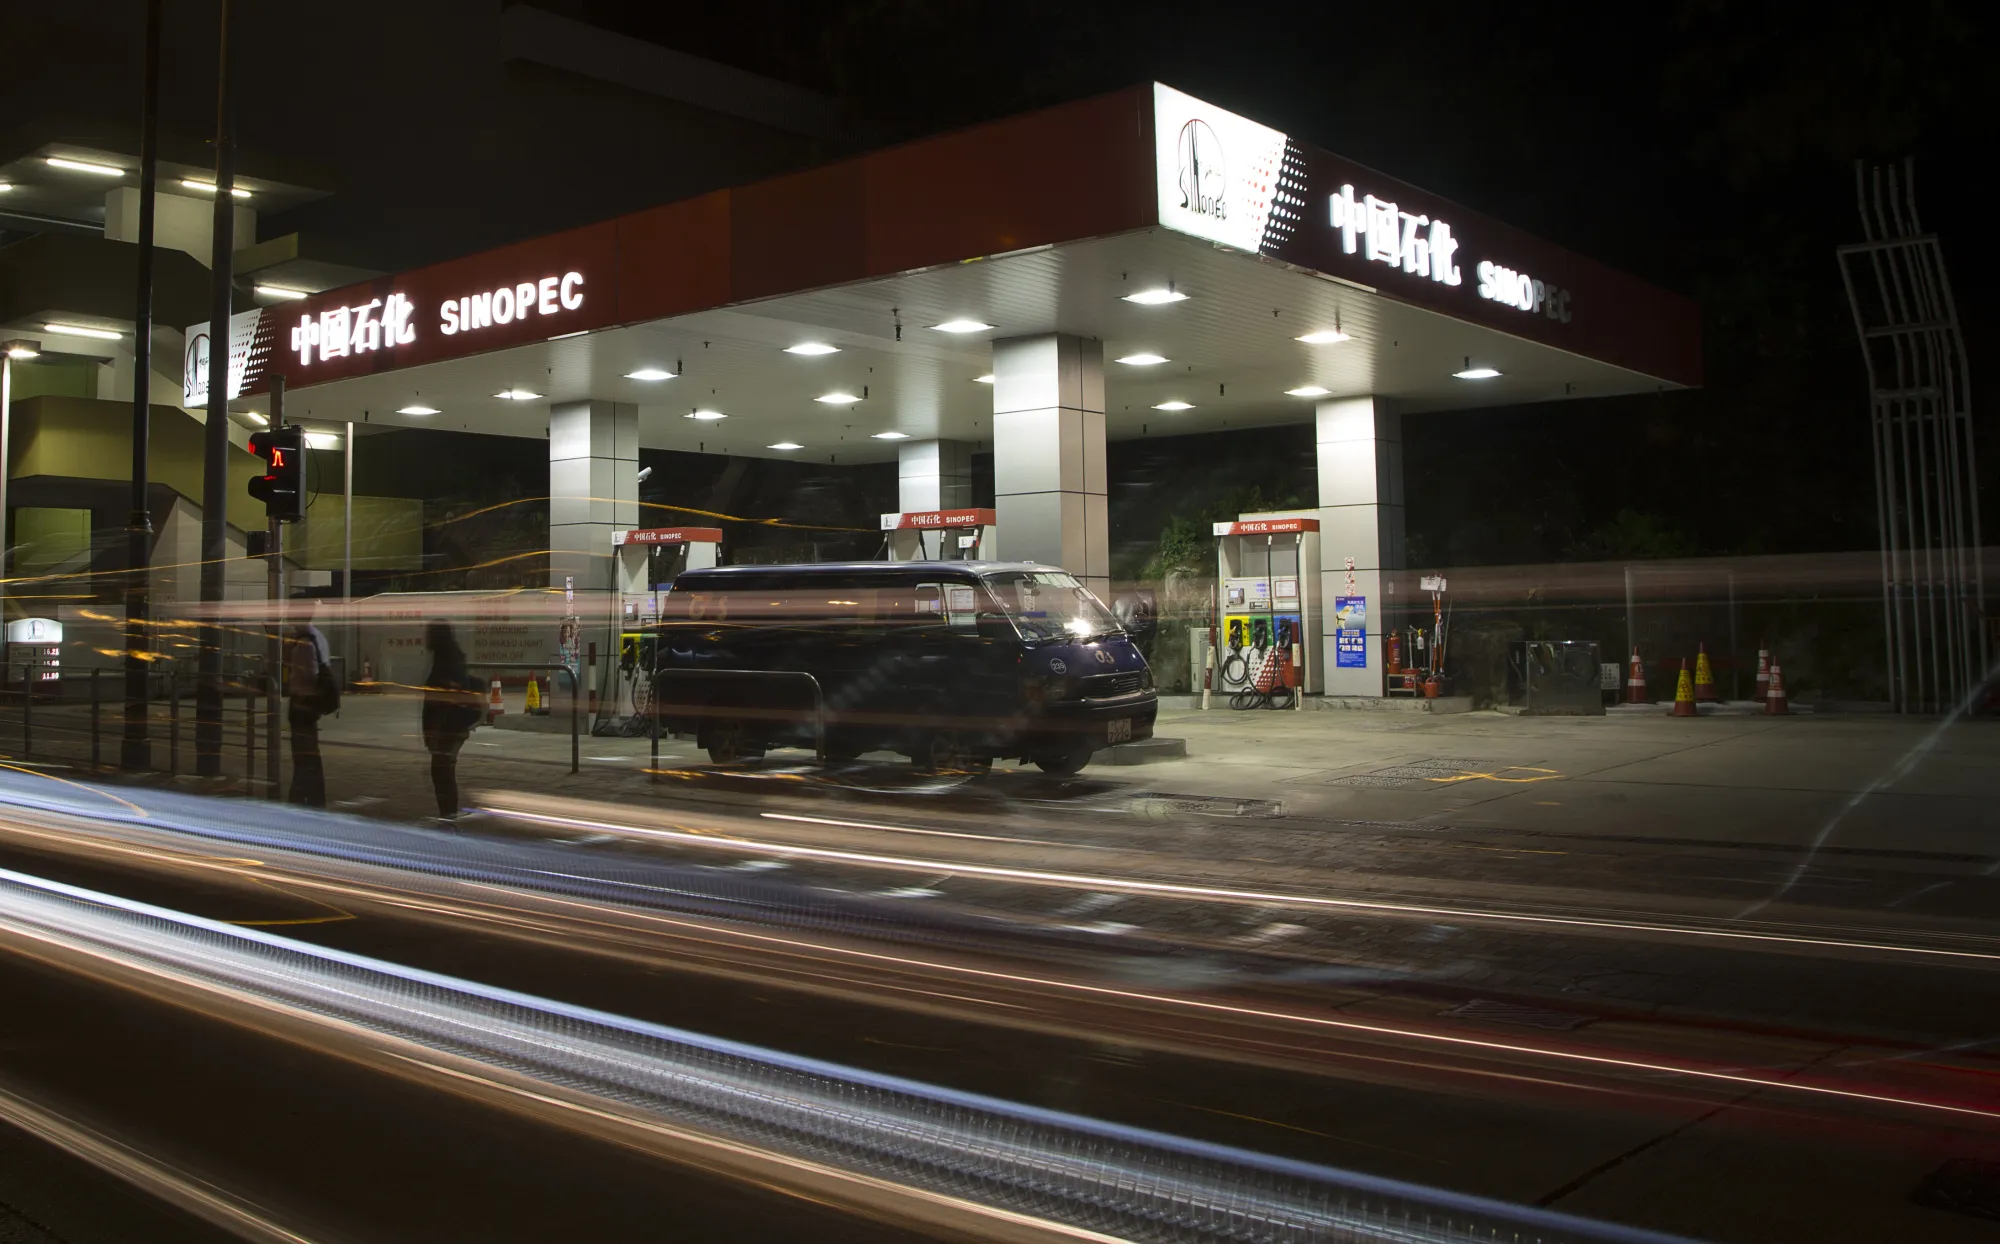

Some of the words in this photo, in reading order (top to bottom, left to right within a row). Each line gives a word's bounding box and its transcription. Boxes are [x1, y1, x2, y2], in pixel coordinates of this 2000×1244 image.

[1329, 184, 1461, 286] 中国石化
[440, 272, 583, 335] SINOPEC
[1477, 260, 1572, 324] SINOPEC
[292, 293, 415, 365] 中国石化
[660, 532, 682, 540] SINOPEC
[911, 514, 941, 525] 中国石化
[945, 515, 975, 524] SINOPEC
[475, 639, 487, 647] NO
